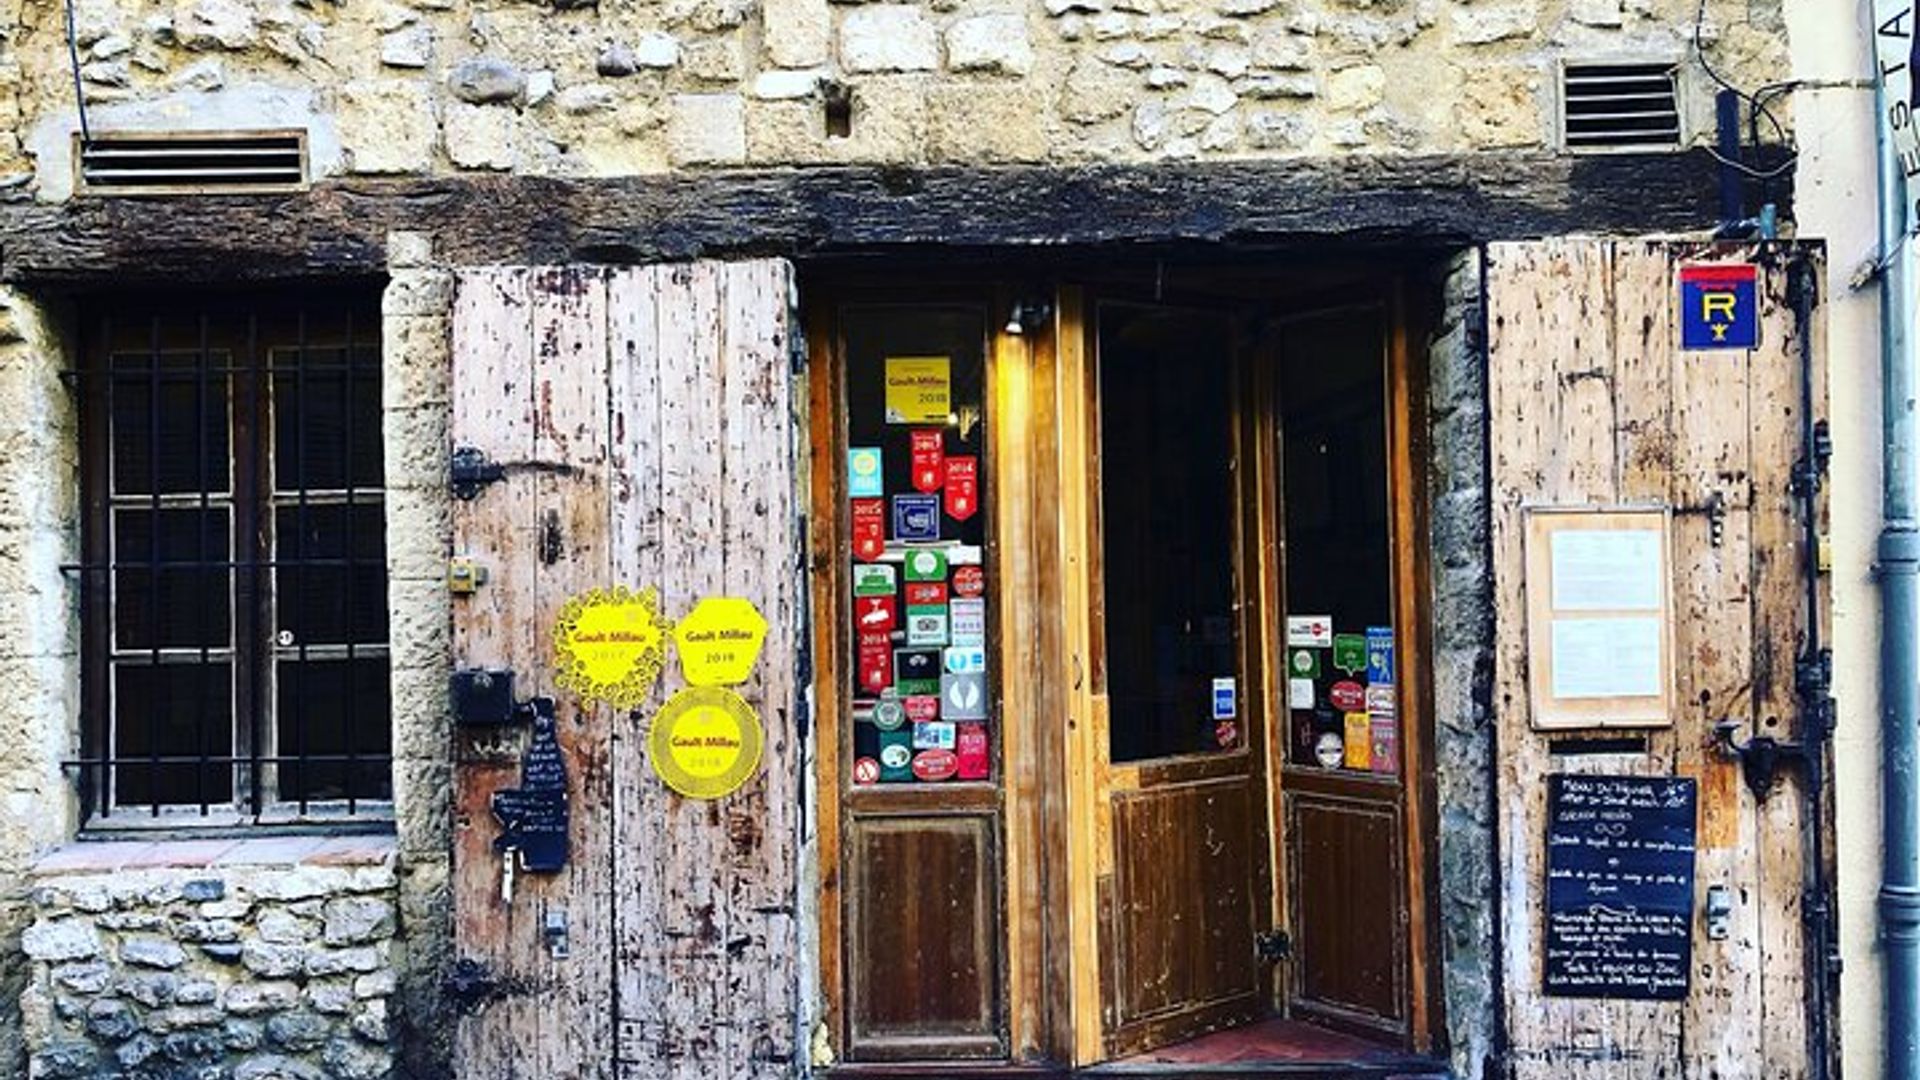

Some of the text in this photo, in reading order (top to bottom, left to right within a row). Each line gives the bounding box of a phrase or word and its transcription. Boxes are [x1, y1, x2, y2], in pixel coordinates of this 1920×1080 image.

[1878, 7, 1920, 217] ESTA
[1703, 292, 1737, 322] R
[574, 631, 646, 643] Gault Millau
[686, 629, 753, 642] Gault Millau
[672, 736, 740, 748] Gault Millau
